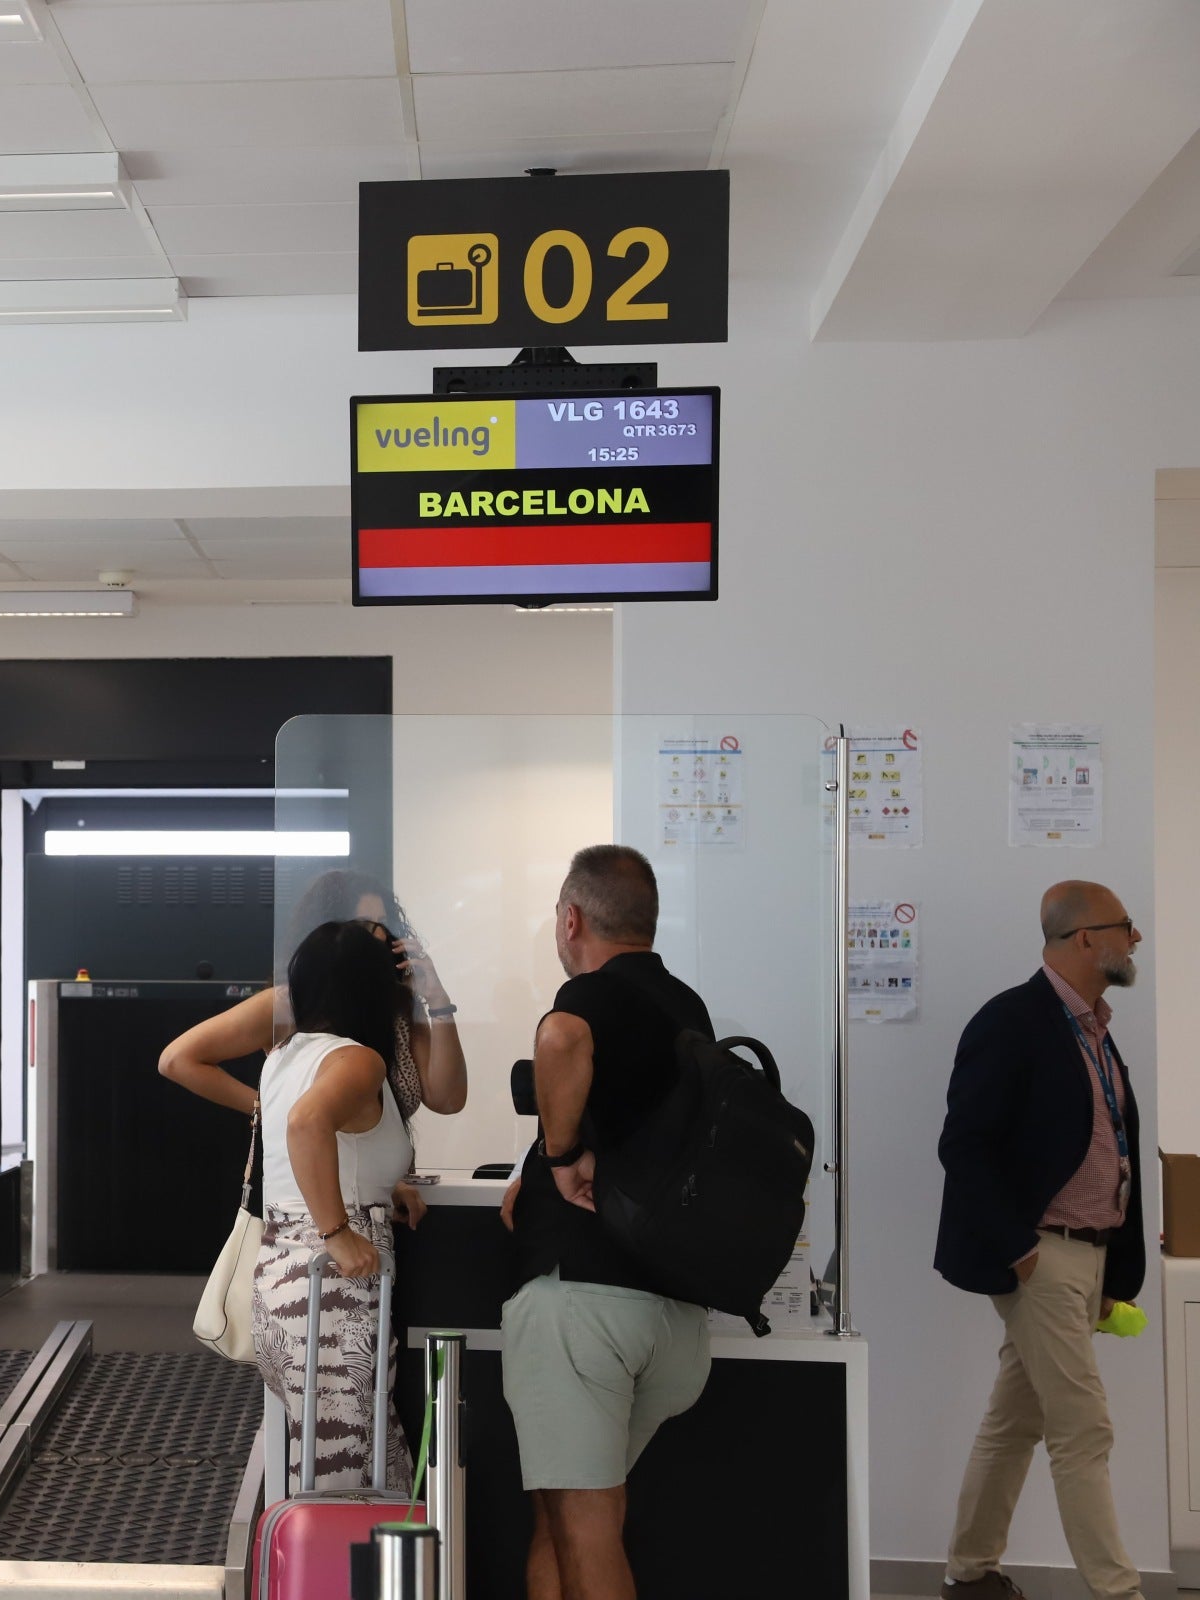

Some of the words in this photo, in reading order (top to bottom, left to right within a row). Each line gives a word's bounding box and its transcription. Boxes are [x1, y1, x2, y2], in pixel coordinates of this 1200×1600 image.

[523, 226, 670, 324] 02
[548, 402, 604, 422] VLG
[613, 400, 679, 420] 1643
[375, 416, 490, 456] vueling
[588, 447, 639, 462] 15:25
[419, 488, 650, 517] BARCELONA
